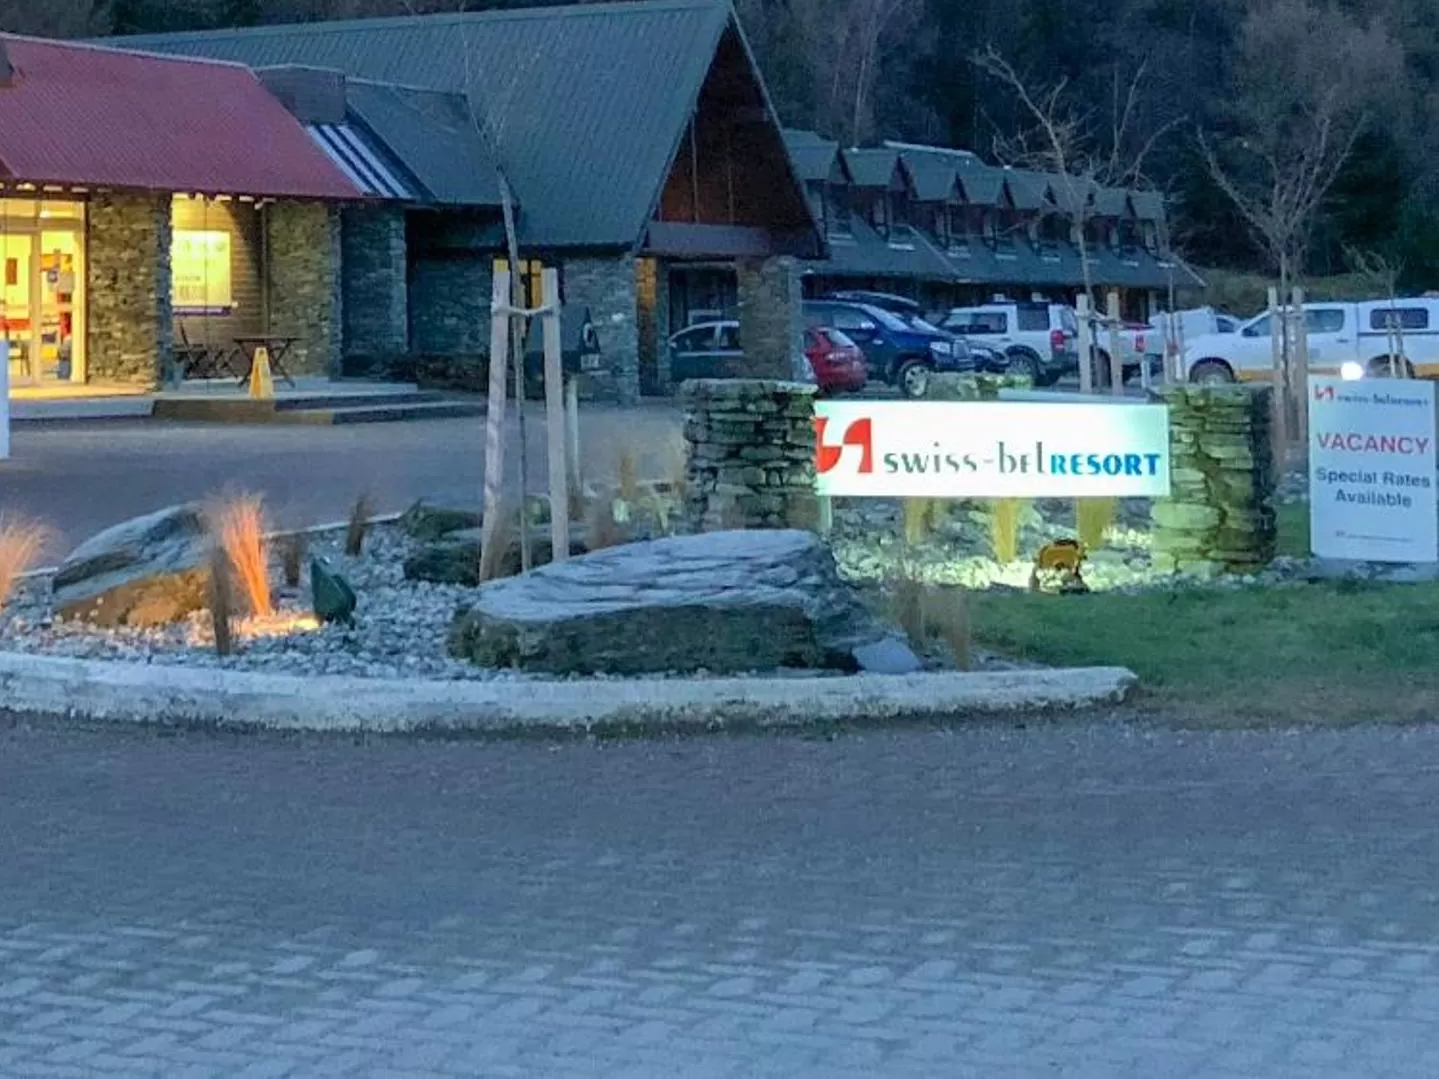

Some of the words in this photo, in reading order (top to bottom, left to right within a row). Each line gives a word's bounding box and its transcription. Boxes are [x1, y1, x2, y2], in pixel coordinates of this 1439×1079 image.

[1317, 432, 1430, 455] VACANCY
[1316, 466, 1378, 484] Special
[1382, 471, 1431, 488] Rates
[1335, 489, 1413, 508] Available
